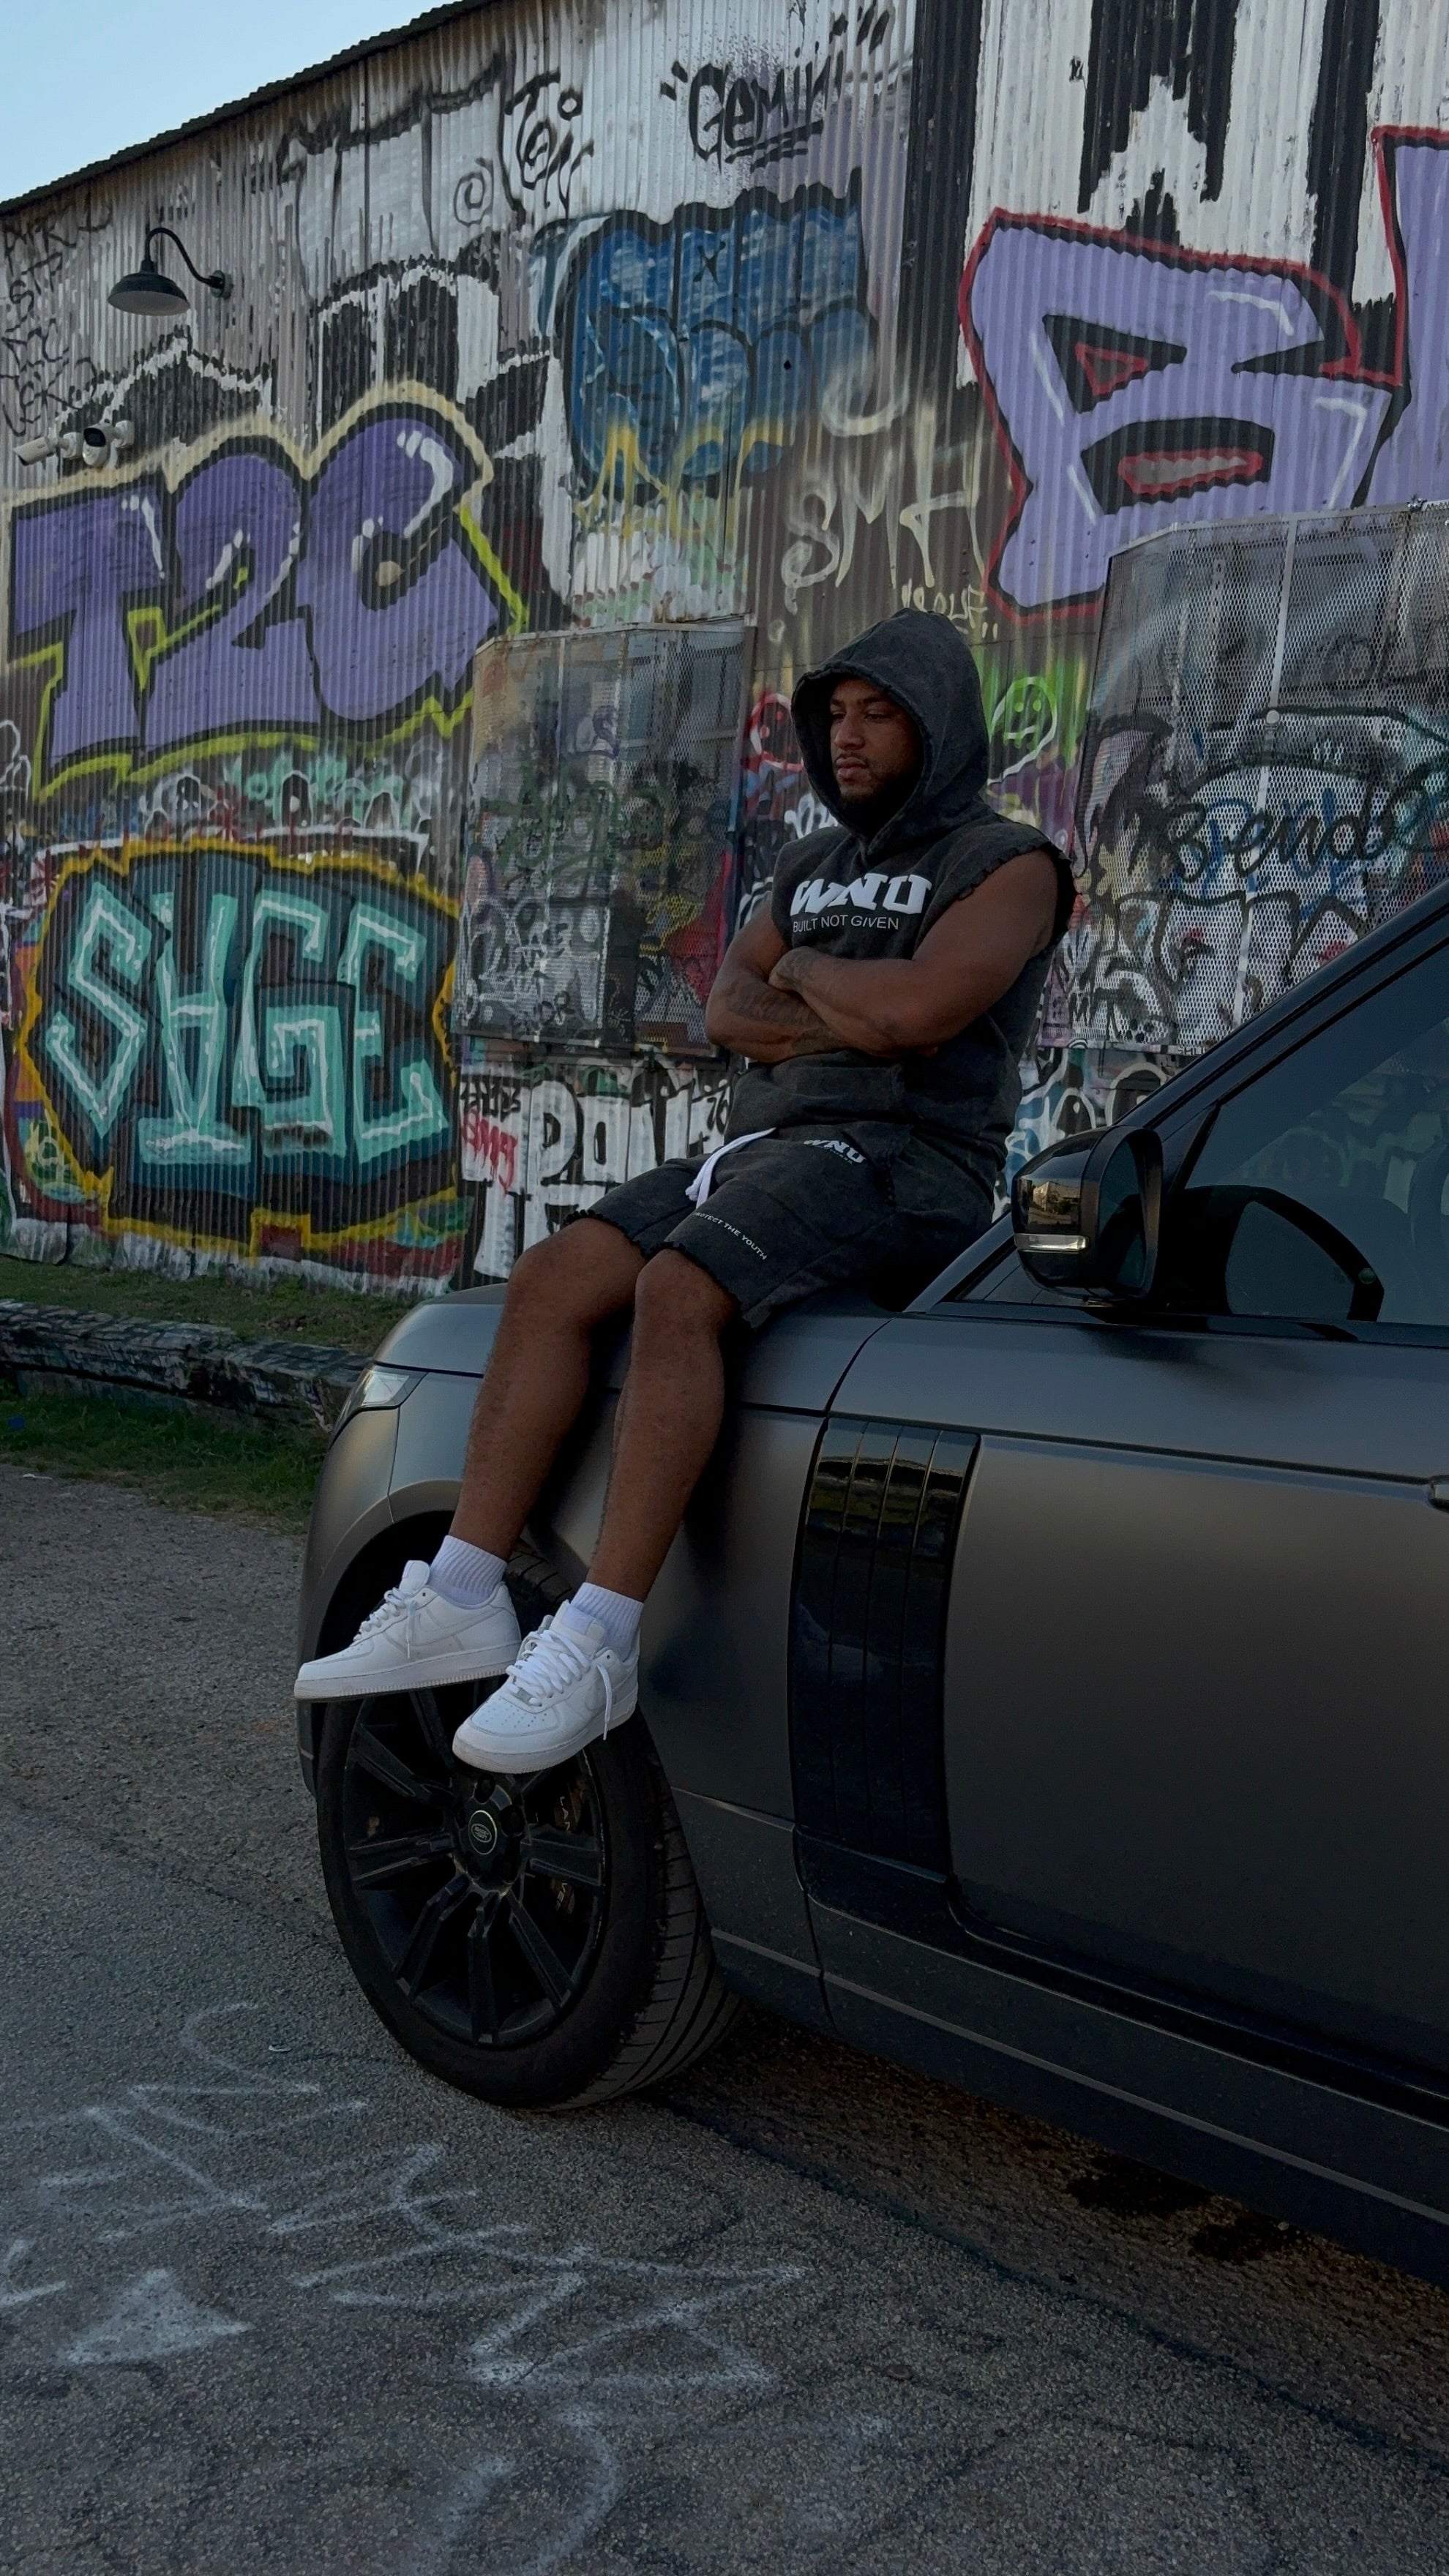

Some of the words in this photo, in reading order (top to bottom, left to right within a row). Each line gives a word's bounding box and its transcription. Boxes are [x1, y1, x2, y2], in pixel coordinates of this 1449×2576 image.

[793, 917, 819, 933] BUILT
[820, 914, 849, 929] NOT
[850, 915, 899, 930] GIVEN
[724, 1222, 742, 1237] THE
[741, 1235, 768, 1260] YOUTH
